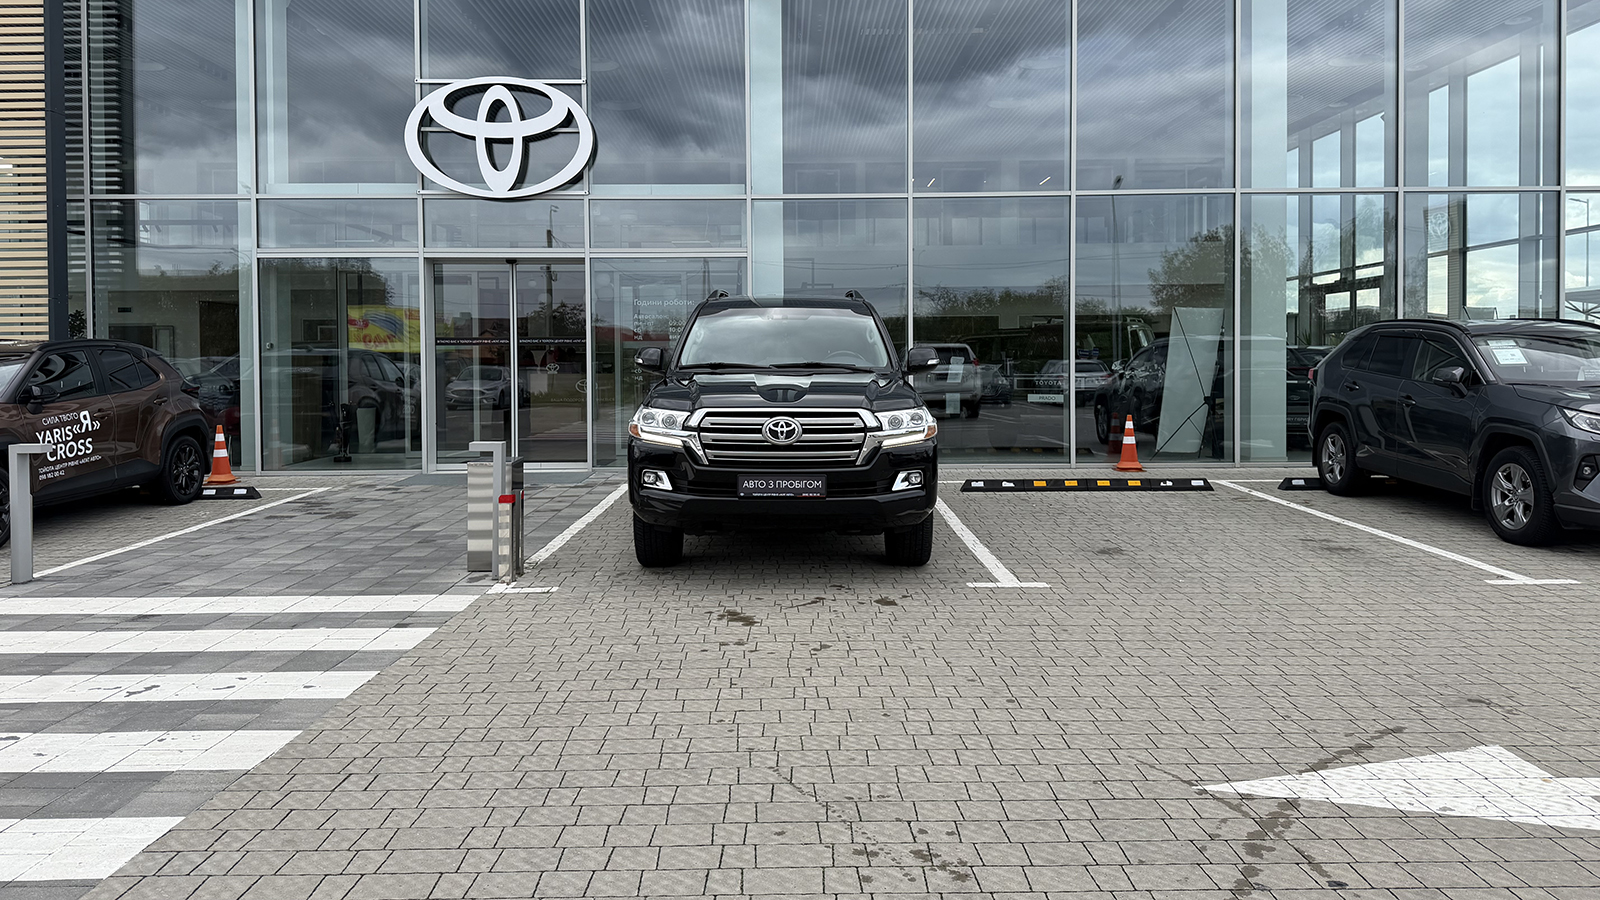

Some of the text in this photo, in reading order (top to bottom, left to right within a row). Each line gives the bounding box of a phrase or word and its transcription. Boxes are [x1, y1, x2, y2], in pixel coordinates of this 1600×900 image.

[664, 299, 695, 307] роботи:
[42, 414, 60, 426] СИЛА
[59, 412, 79, 422] ТВОГО
[46, 437, 94, 462] CROSS
[742, 480, 767, 489] АВТО
[775, 480, 822, 489] ПРОБІГОМ
